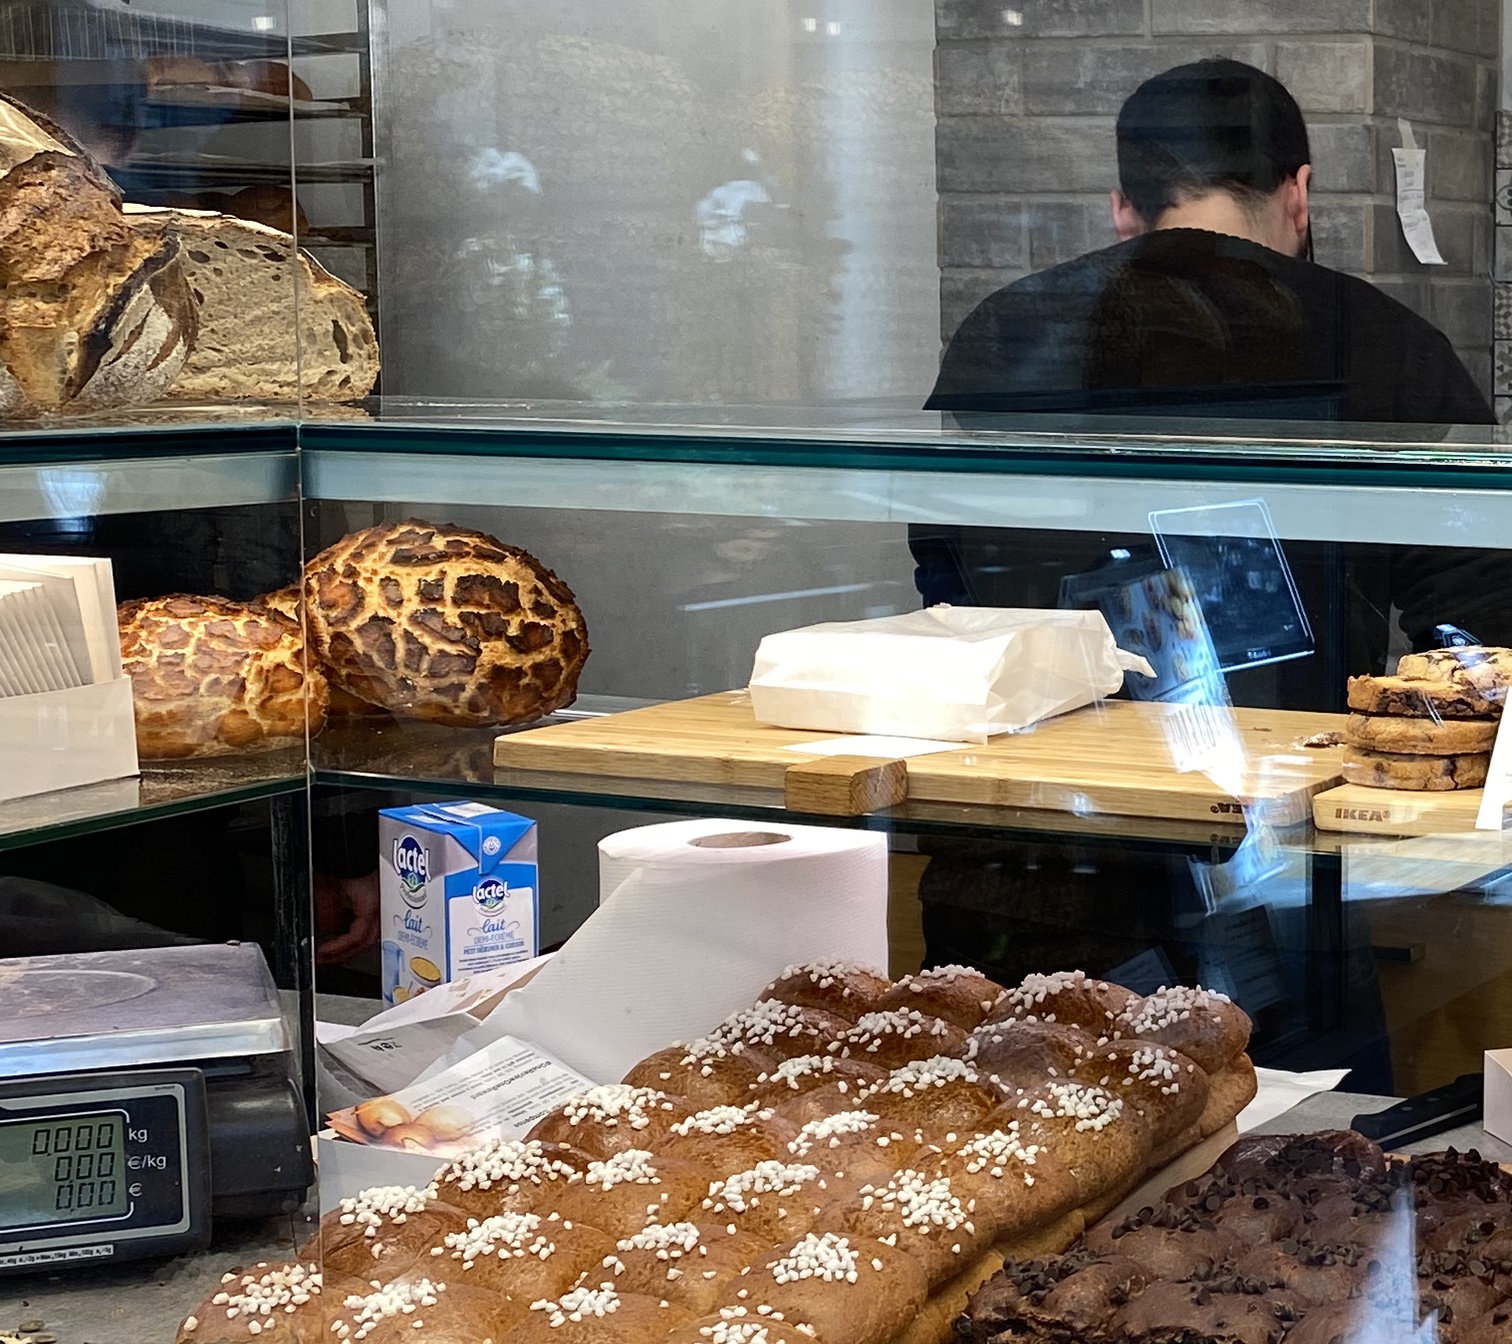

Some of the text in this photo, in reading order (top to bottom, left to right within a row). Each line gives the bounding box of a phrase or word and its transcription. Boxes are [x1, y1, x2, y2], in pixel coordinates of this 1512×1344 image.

[393, 838, 432, 882] lactel
[472, 881, 511, 904] lactel
[404, 910, 423, 933] lait
[483, 919, 506, 934] lait
[128, 1128, 148, 1142] kg
[128, 1156, 166, 1169] €/kg
[129, 1183, 142, 1196] €
